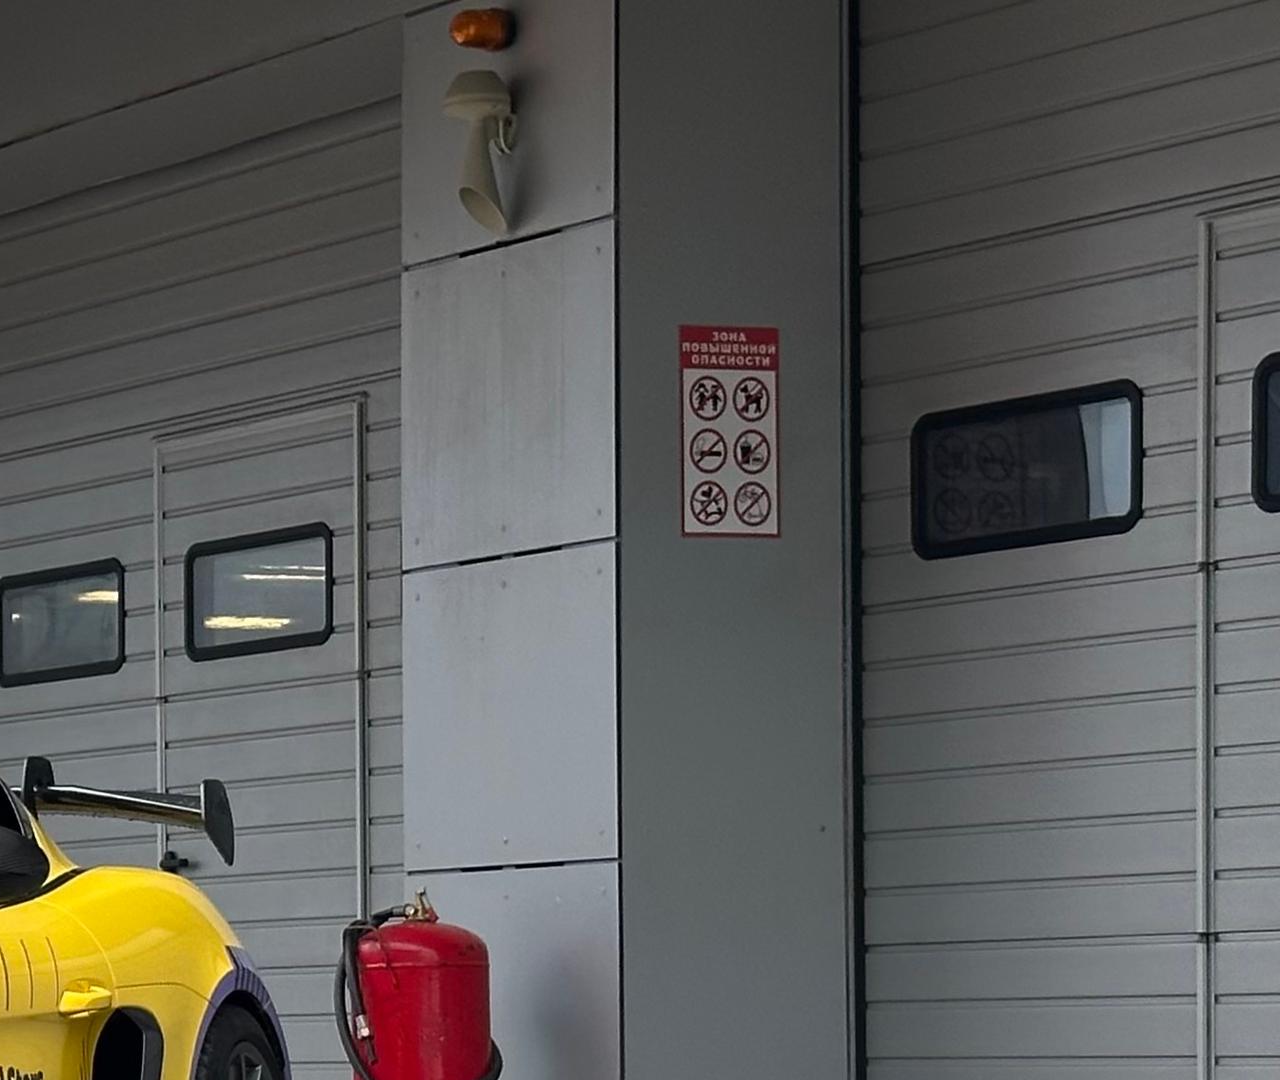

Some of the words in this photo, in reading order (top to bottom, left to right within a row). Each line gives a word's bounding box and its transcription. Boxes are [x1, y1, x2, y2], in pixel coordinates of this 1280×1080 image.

[712, 331, 747, 342] ЗОНА
[682, 342, 777, 354] ПОВЫШЕННОЙ
[691, 354, 771, 366] ОПАСНОСТИ
